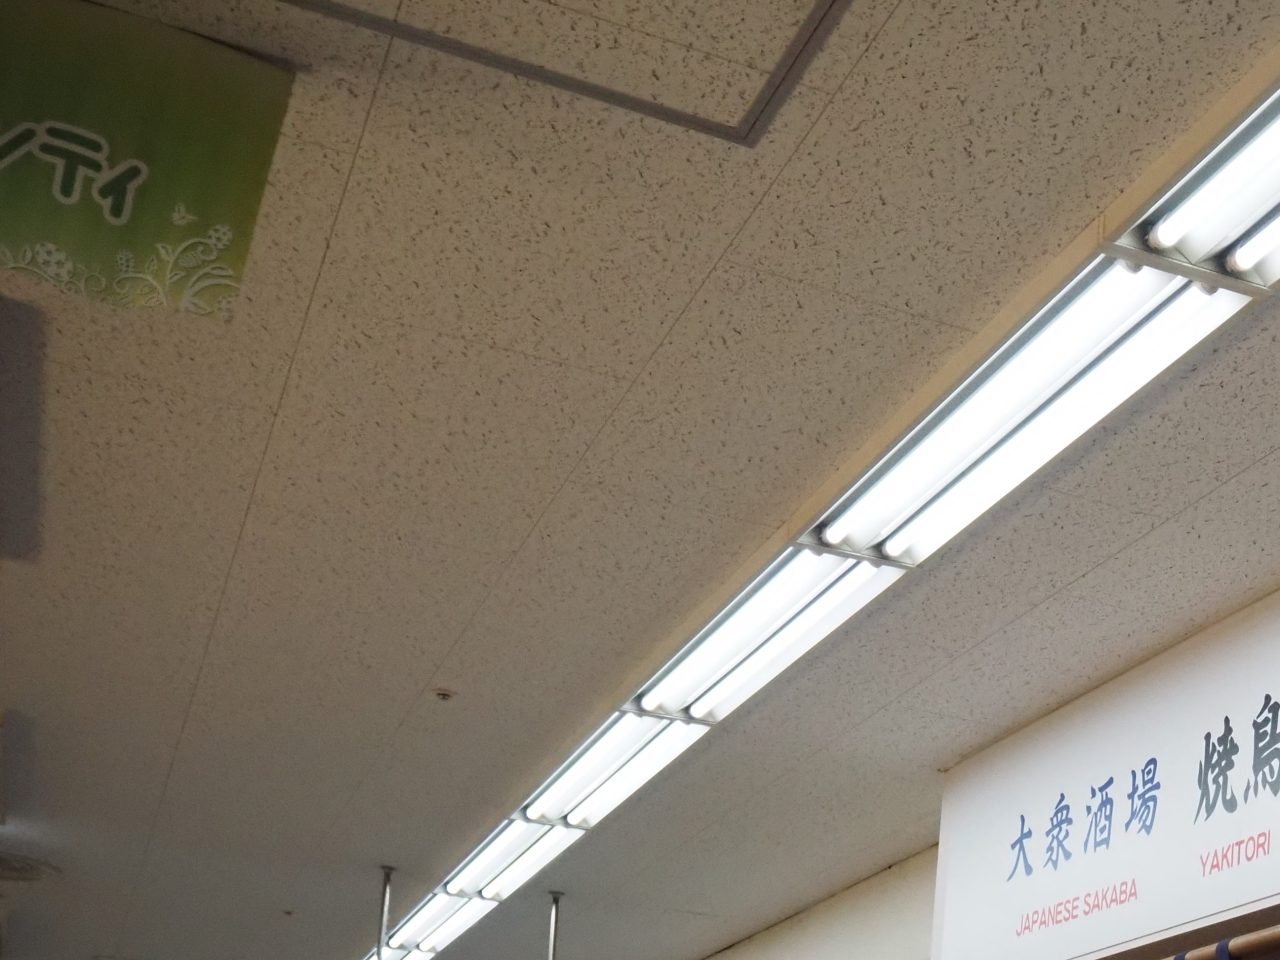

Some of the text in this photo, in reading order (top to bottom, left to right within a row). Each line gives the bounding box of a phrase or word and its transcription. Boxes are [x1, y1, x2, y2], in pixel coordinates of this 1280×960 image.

[1006, 757, 1162, 882] 大衆酒場
[1199, 830, 1272, 877] YAKITORI
[1015, 878, 1139, 938] JAPANESE SAKABA
